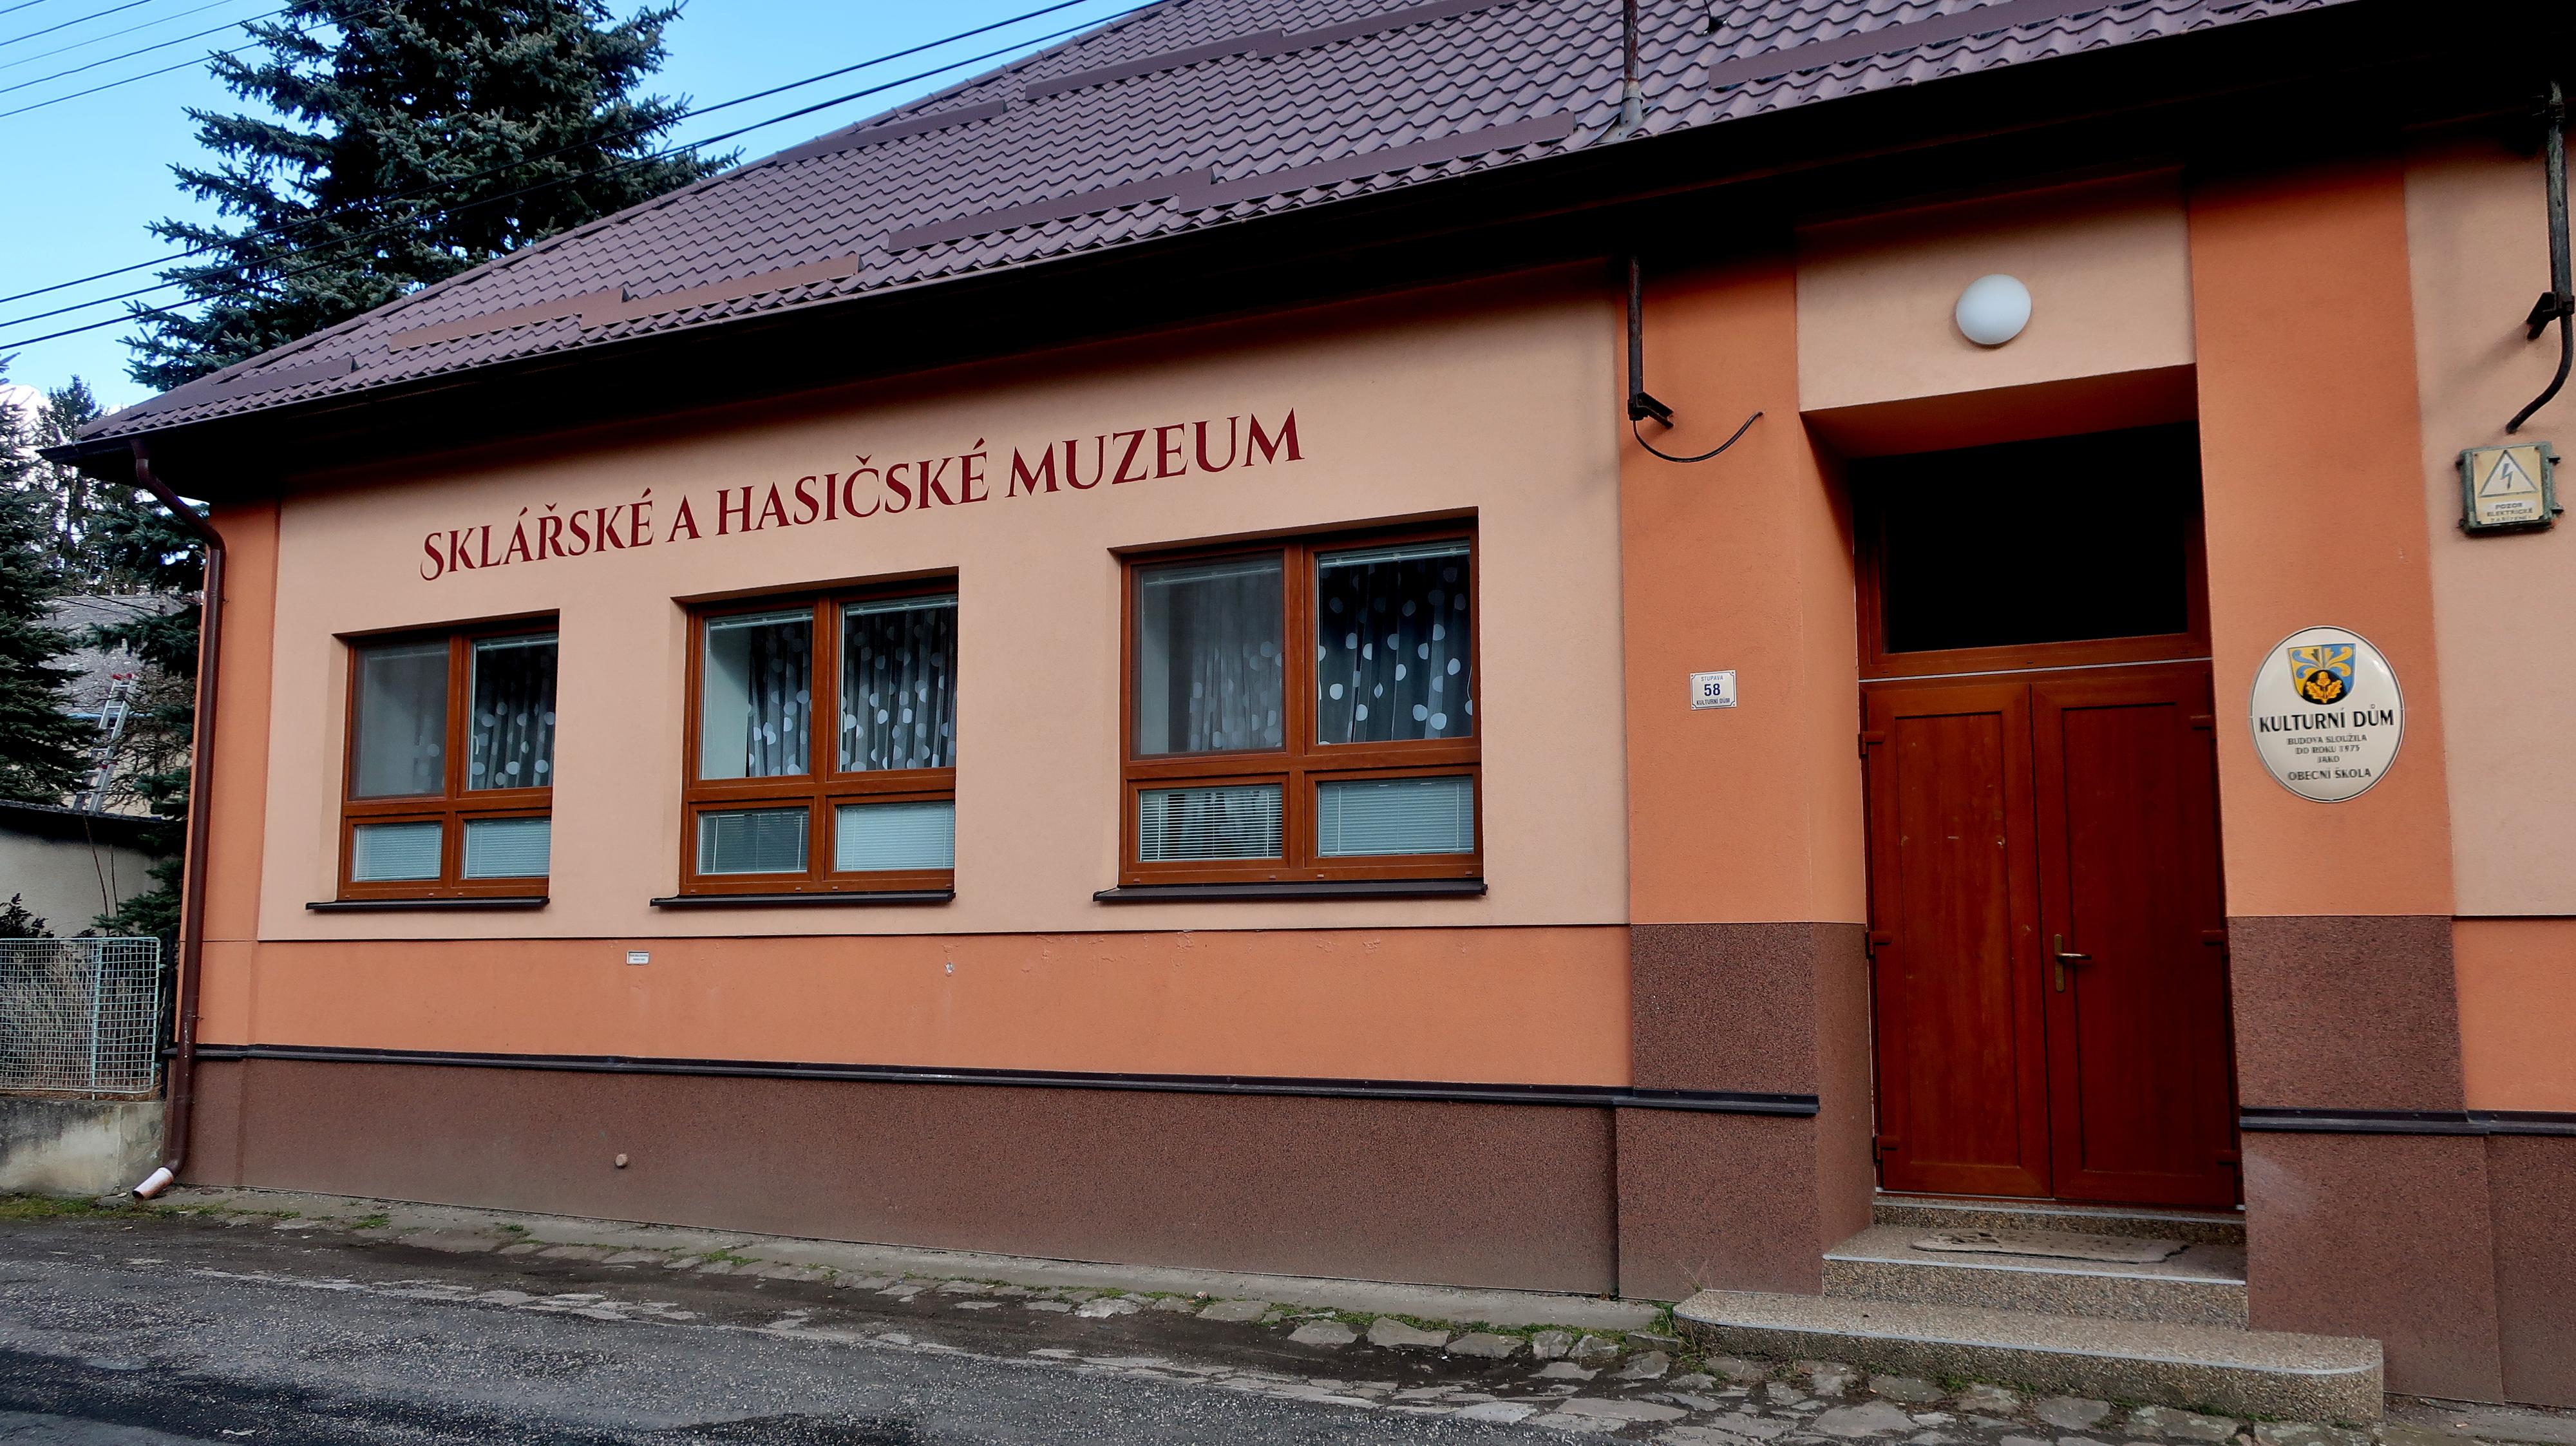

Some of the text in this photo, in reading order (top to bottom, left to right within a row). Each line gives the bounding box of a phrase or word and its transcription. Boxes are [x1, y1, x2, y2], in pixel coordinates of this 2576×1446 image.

[421, 407, 1305, 580] SKLÁŘSKÉ A HASIČSKÉ MUZEUM
[1704, 683, 1721, 696] 58
[2260, 703, 2394, 732] KULTURNÍ DŮM
[2287, 733, 2367, 745] BUDOVA SLOUŽILA
[2335, 766, 2371, 779] ŠKOLA
